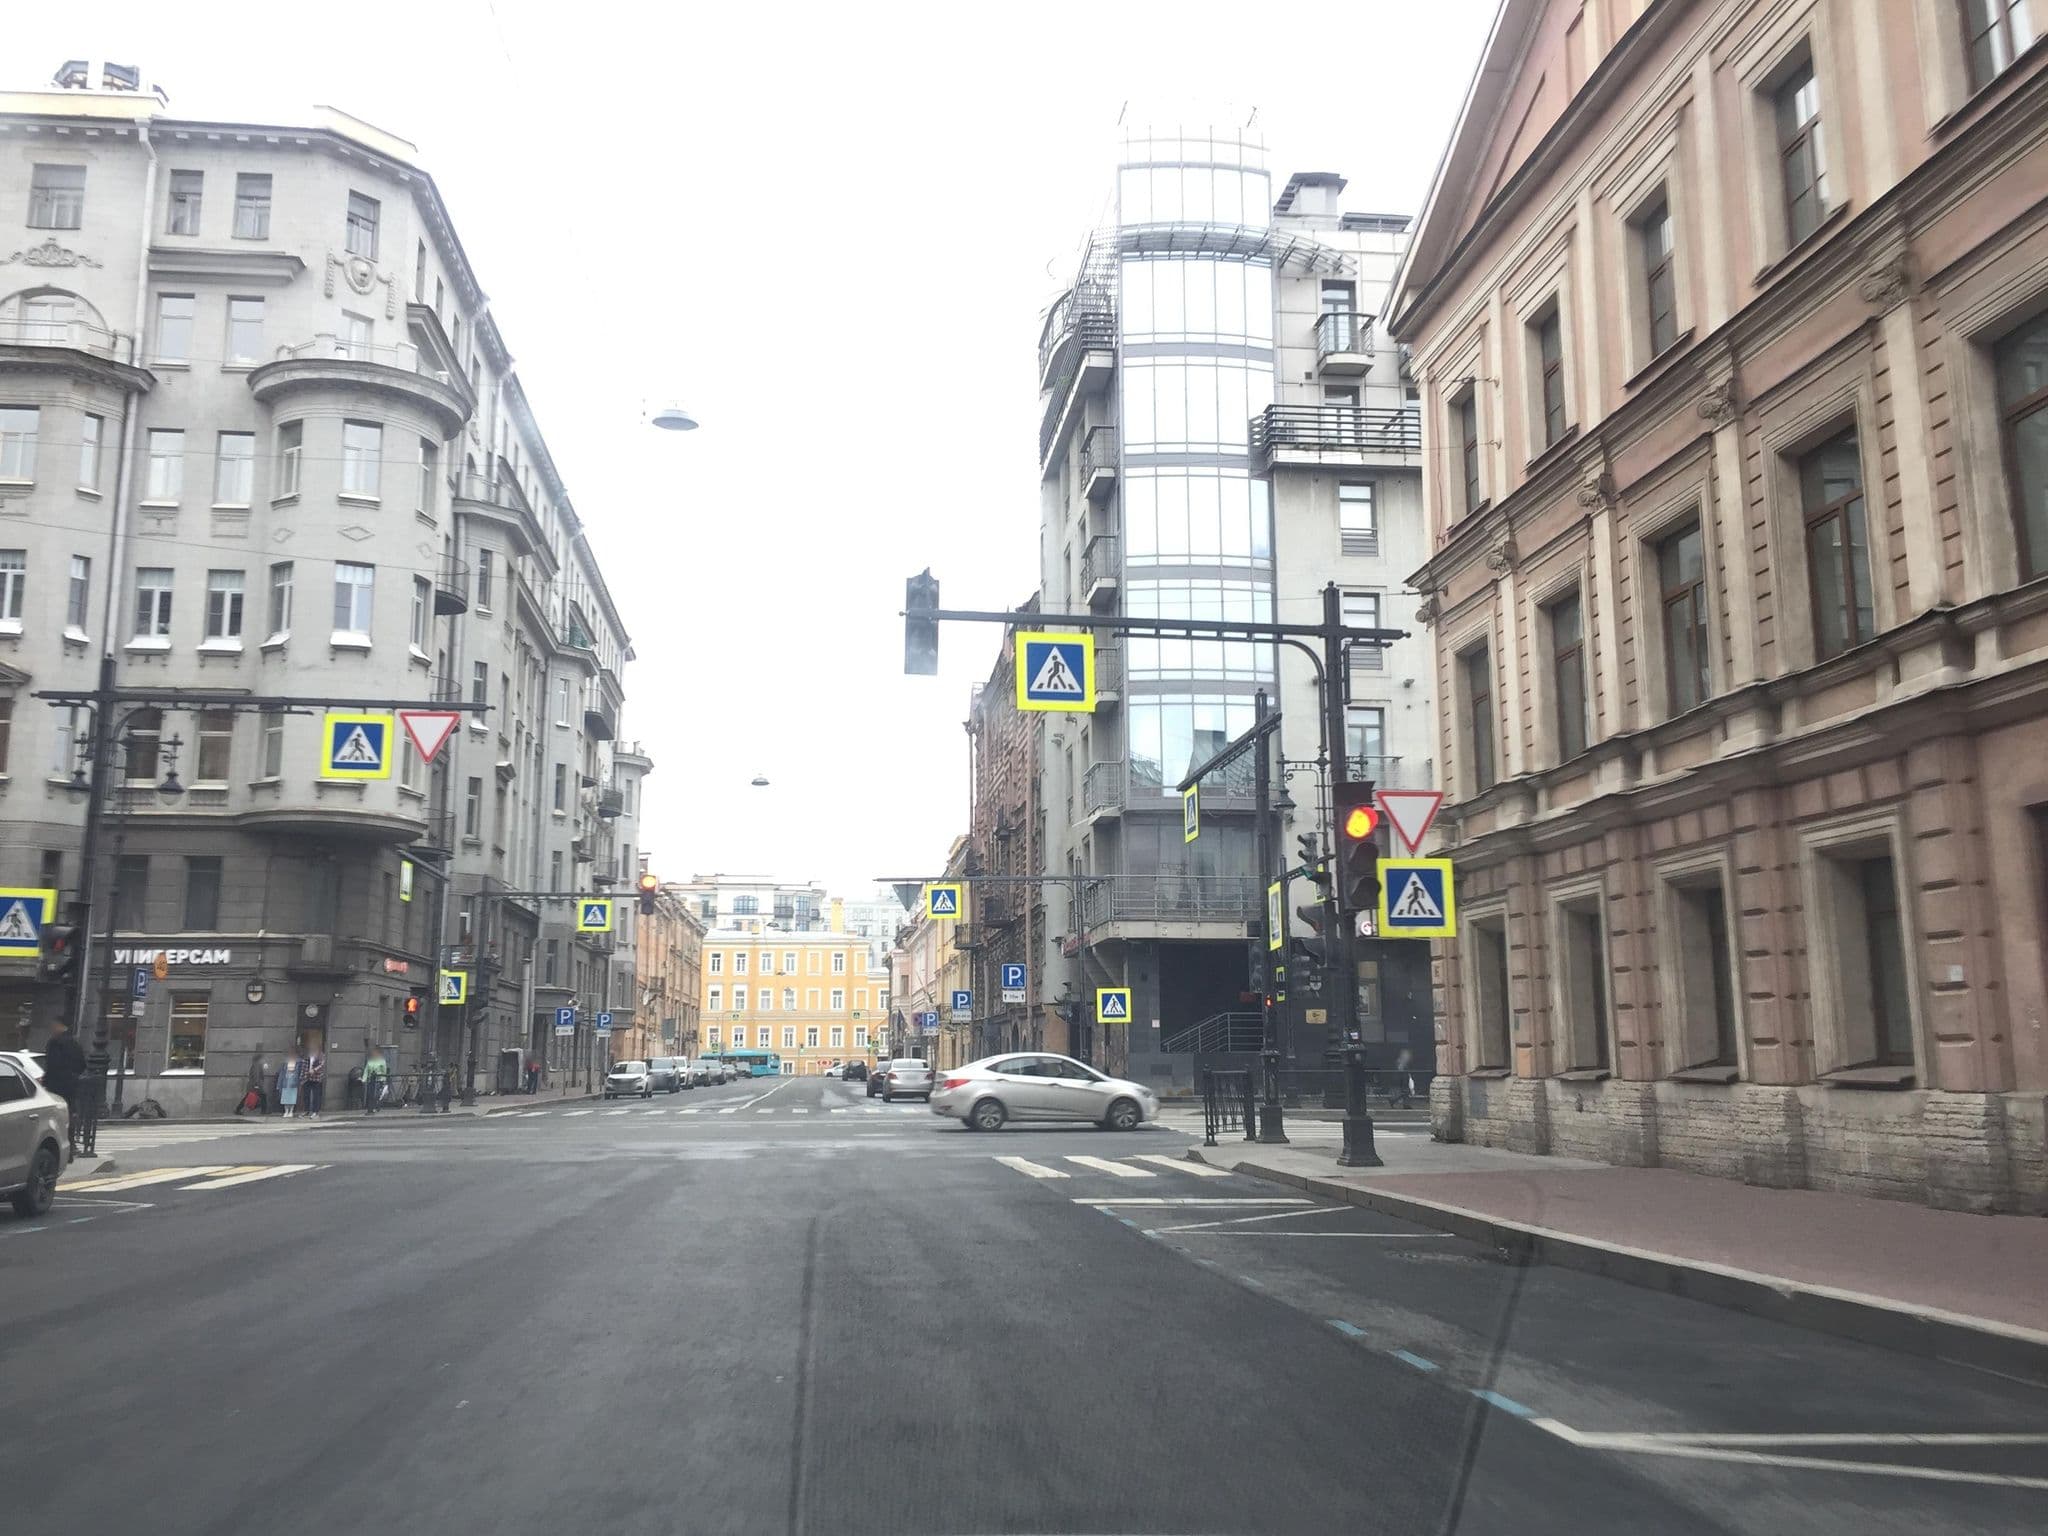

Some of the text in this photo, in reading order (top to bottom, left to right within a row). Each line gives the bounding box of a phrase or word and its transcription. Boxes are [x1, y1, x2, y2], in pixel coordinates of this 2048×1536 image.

[1009, 967, 1021, 985] P
[957, 994, 967, 1009] P
[561, 1010, 572, 1024] P
